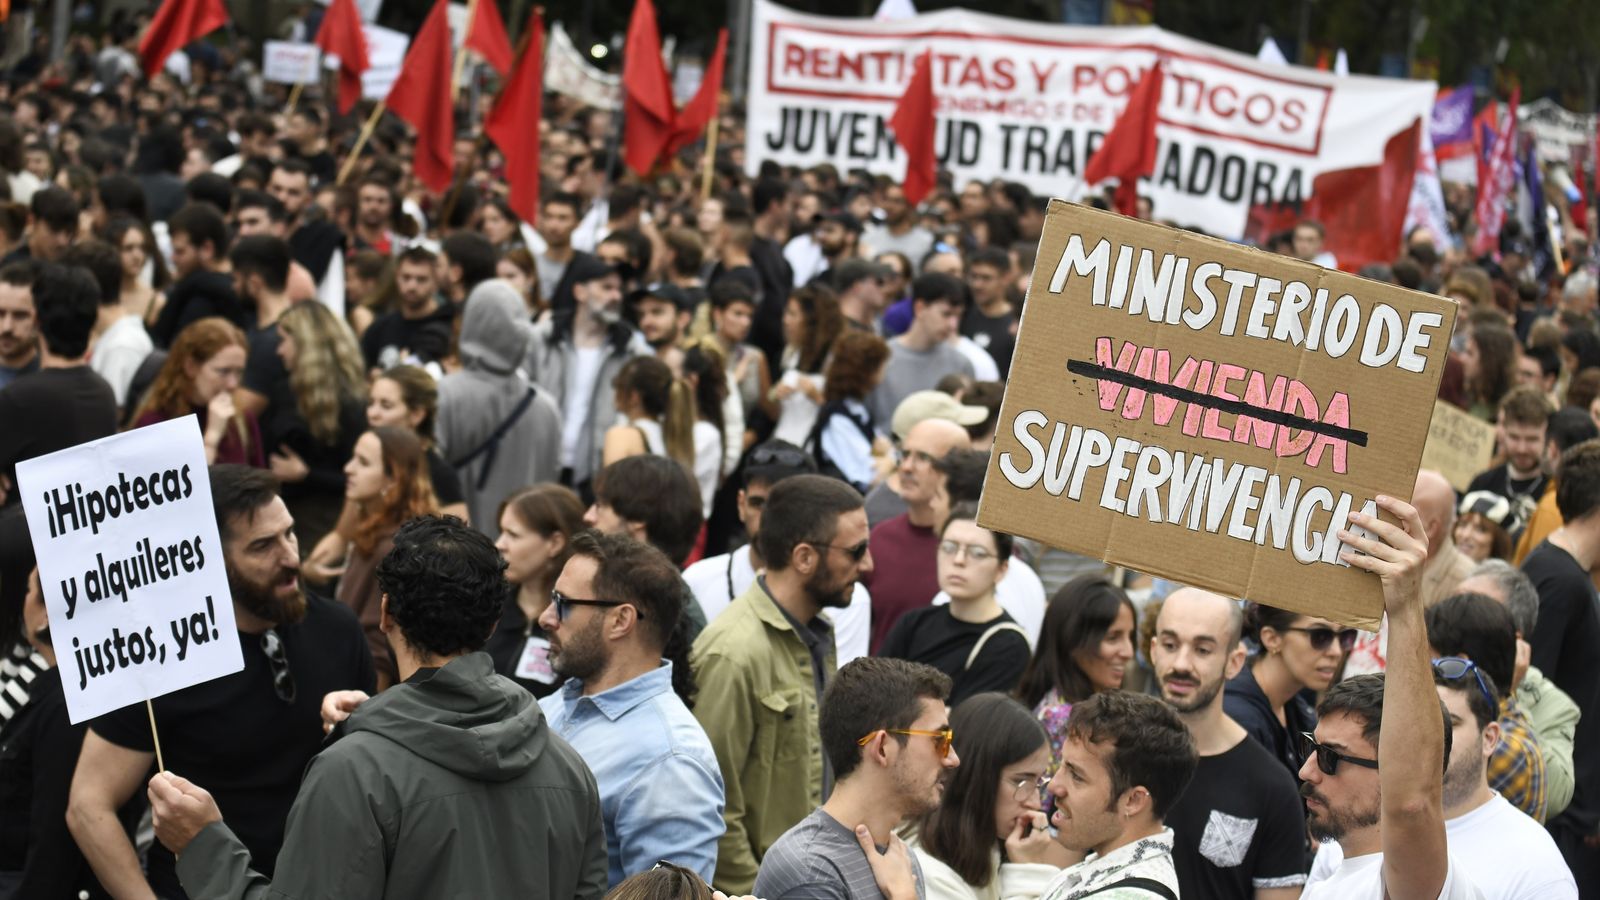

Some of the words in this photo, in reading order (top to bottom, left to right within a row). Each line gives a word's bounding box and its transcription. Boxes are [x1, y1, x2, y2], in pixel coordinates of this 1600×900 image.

[784, 43, 1017, 91] RENTITAS
[1031, 61, 1057, 94] Y
[1072, 63, 1307, 134] POTICOS
[766, 106, 982, 168] JUVENUD
[998, 123, 1304, 213] TRAADORA
[1048, 233, 1361, 359] MINISTERIO
[1359, 302, 1443, 373] DE
[1095, 336, 1351, 475] VIVIENDA
[43, 463, 192, 538] ¡Hipotecas
[60, 577, 77, 620] y
[84, 535, 205, 603] alquileres
[72, 626, 166, 691] justos,
[170, 595, 219, 661] ya!
